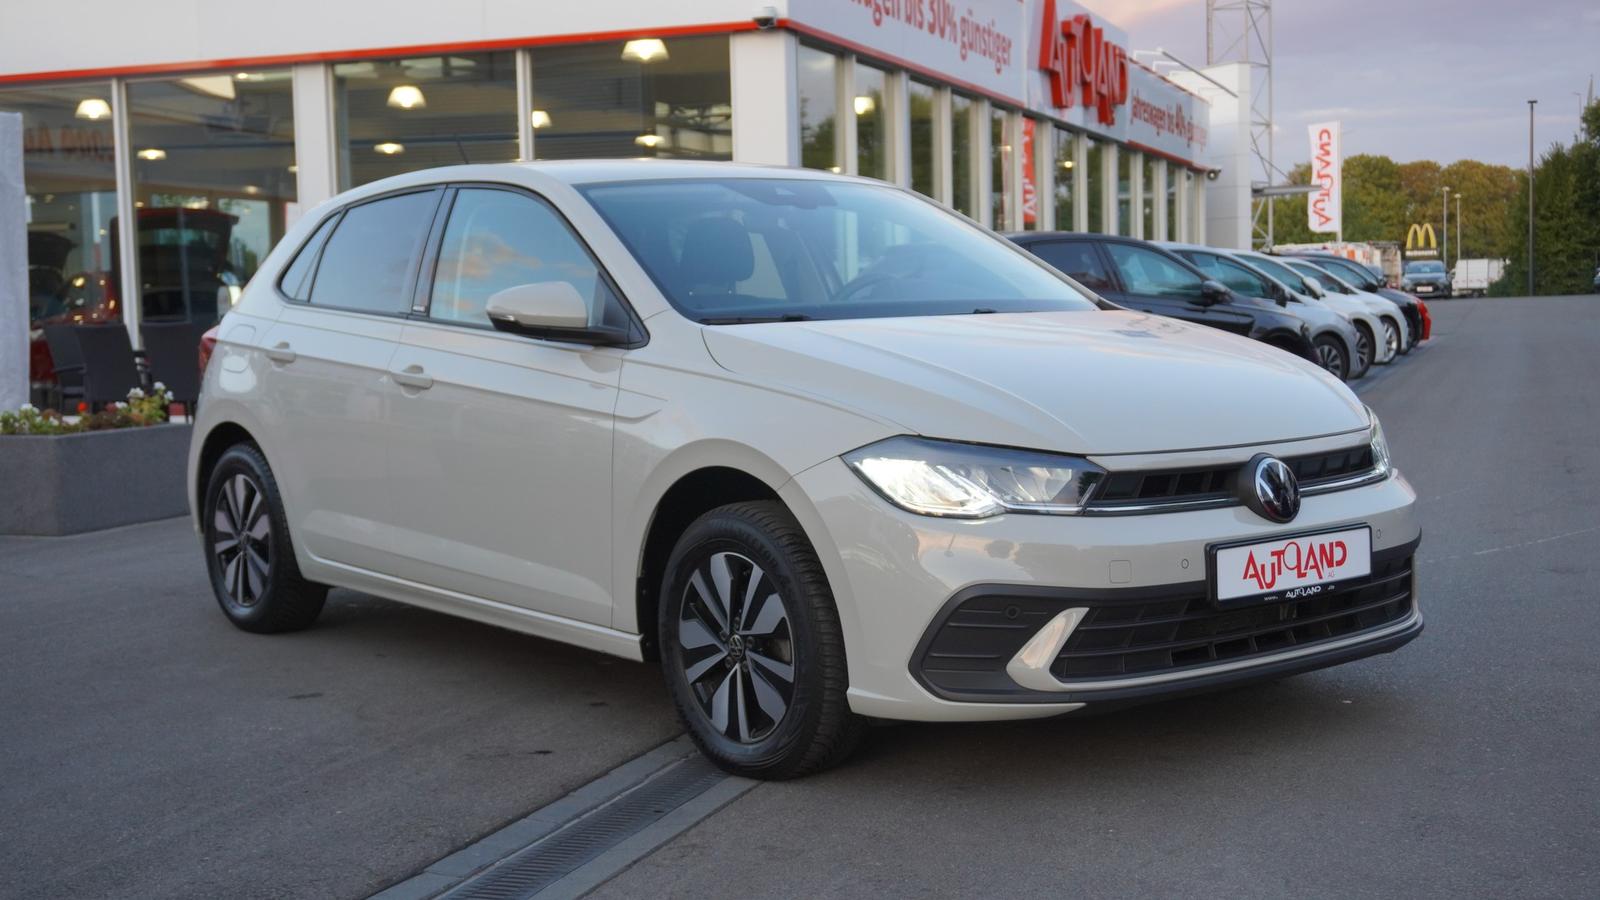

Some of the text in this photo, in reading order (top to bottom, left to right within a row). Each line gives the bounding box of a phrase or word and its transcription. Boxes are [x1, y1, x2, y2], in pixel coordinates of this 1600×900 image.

[960, 9, 1012, 75] günstiger
[1242, 541, 1347, 590] AUTOLAND
[1285, 585, 1321, 599] AUTOLAND
